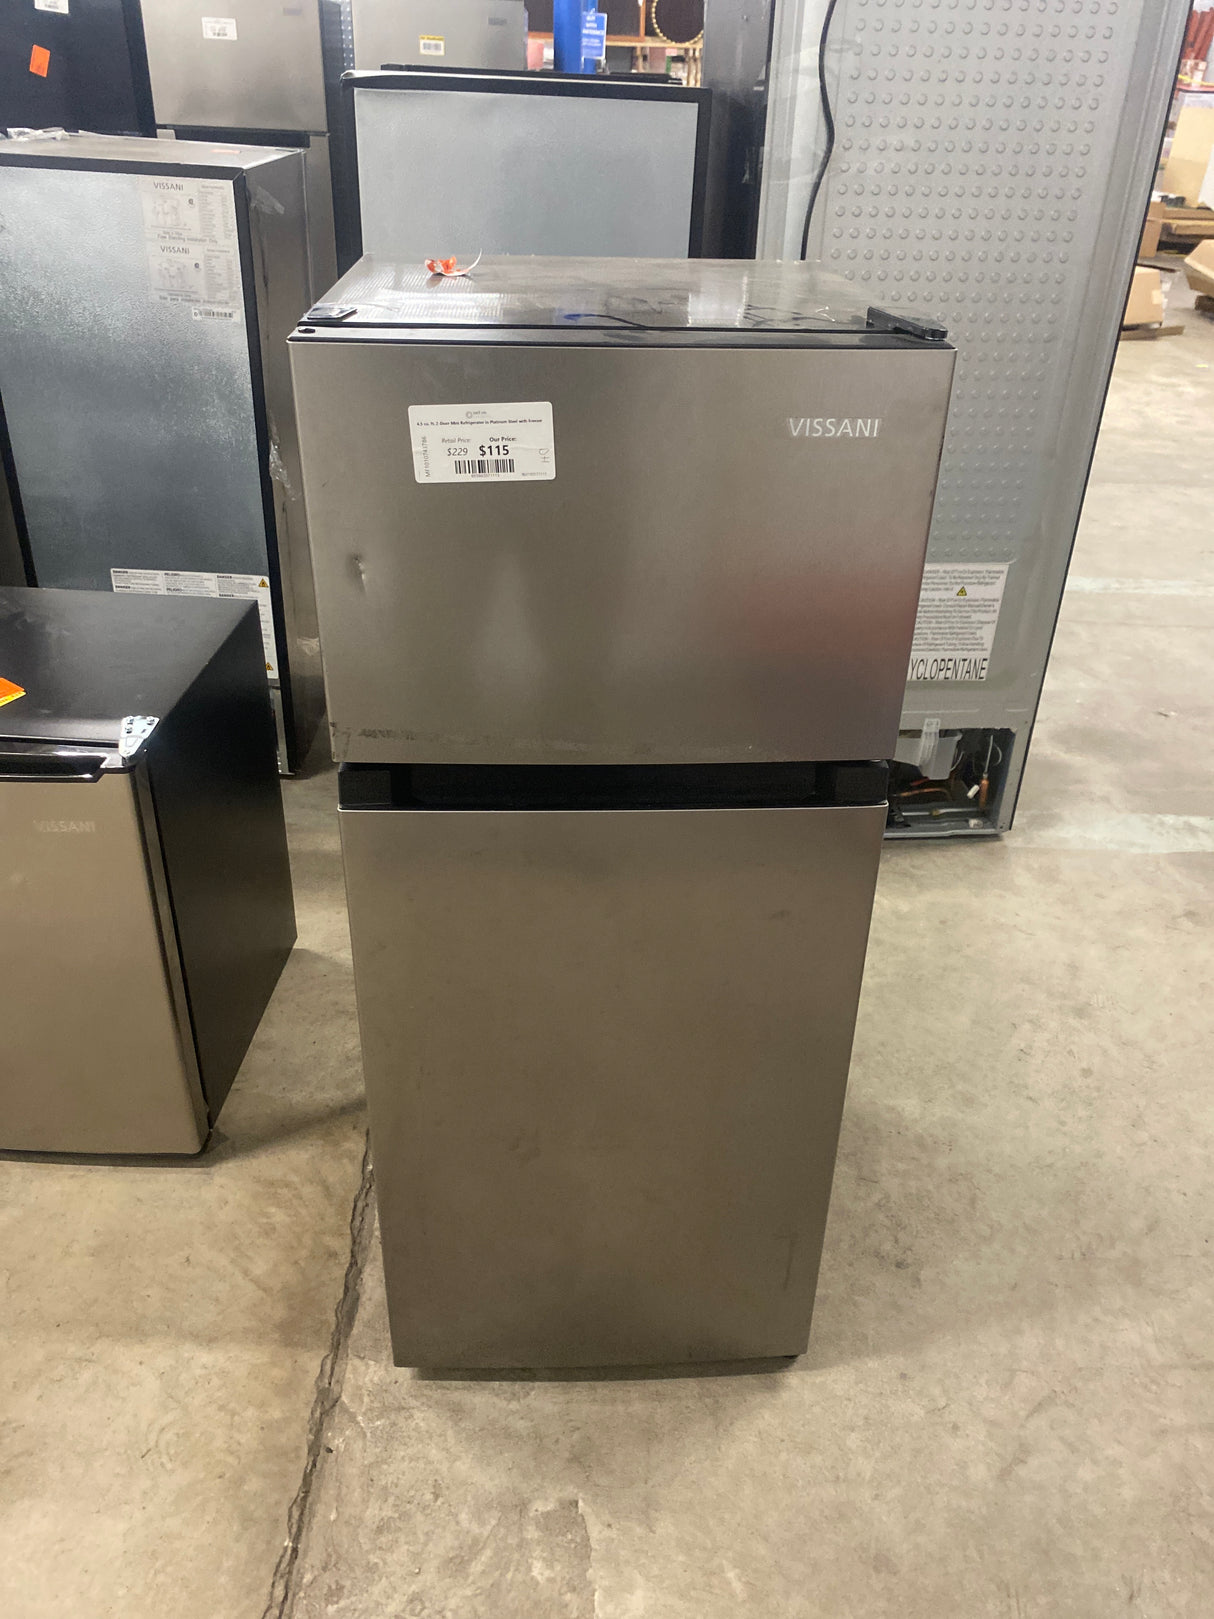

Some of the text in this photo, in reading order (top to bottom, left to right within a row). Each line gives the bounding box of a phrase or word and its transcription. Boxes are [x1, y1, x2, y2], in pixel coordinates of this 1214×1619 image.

[153, 181, 184, 191] VISSANI
[160, 245, 190, 254] VISSANI
[789, 418, 880, 437] VISSANI
[447, 447, 468, 457] $229
[479, 444, 510, 457] $115
[910, 658, 988, 680] YCLOPENTANE
